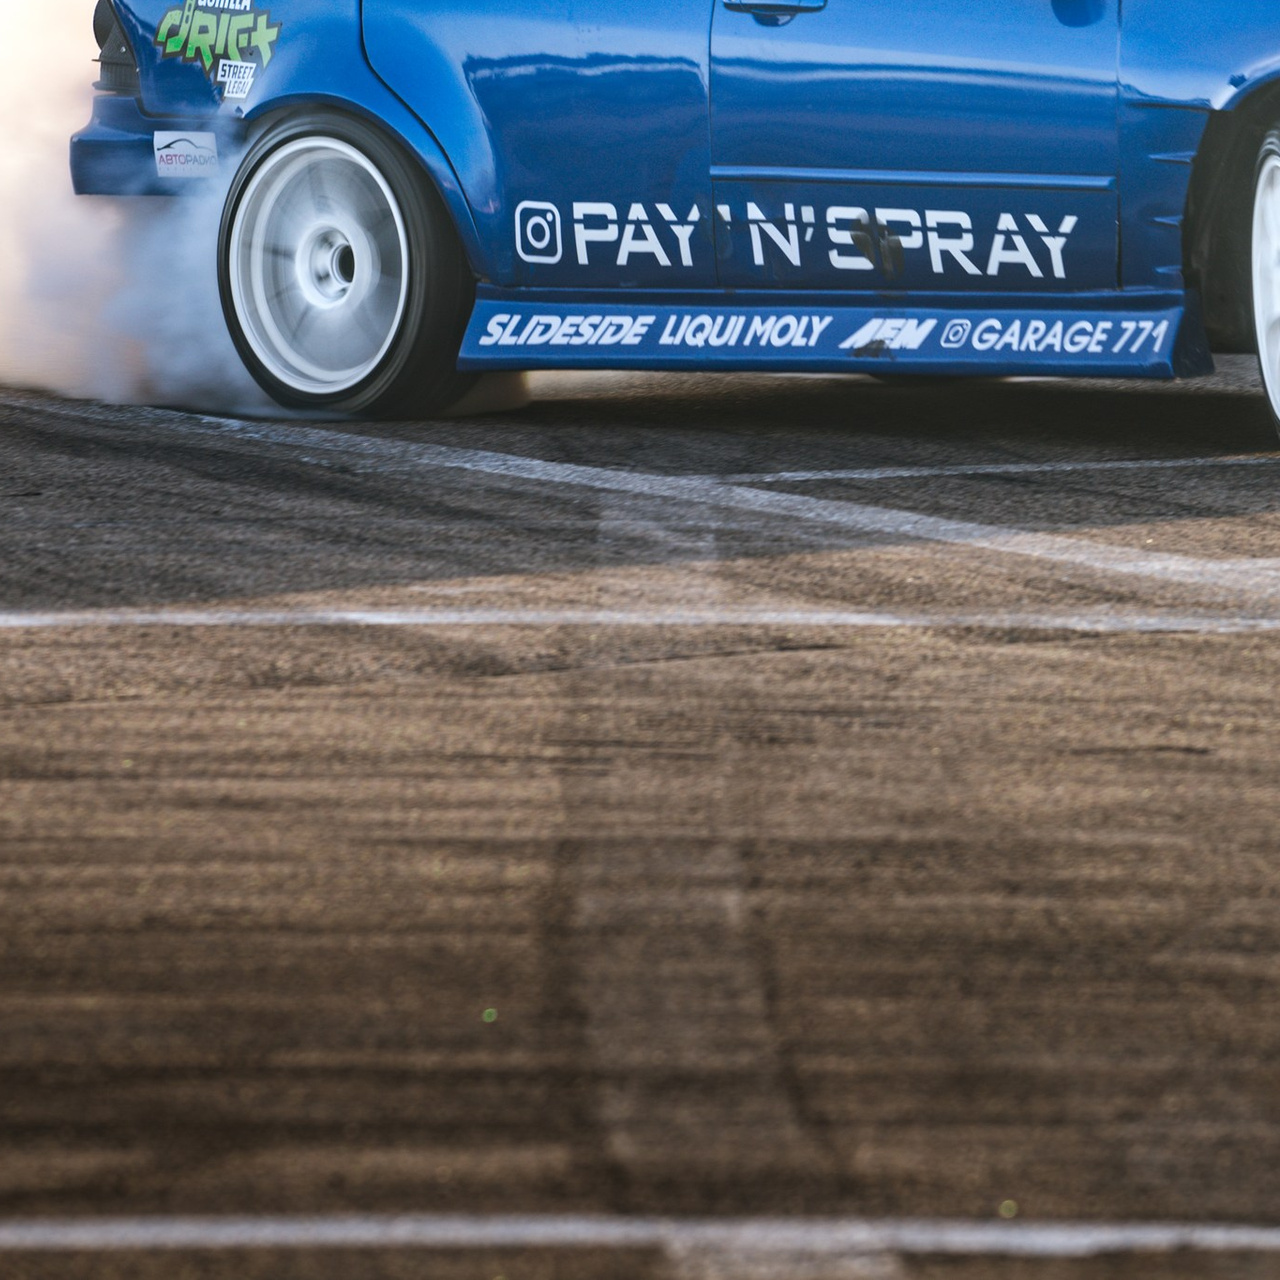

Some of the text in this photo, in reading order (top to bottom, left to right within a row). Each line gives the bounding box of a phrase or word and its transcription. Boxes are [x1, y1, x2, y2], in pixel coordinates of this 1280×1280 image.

[220, 63, 254, 80] STREET
[226, 80, 250, 95] LEGAL
[478, 314, 656, 346] SLIDESIDE
[658, 314, 746, 348] LIQUI
[743, 315, 834, 347] MOLY
[971, 318, 1114, 353] GARAGE
[1111, 319, 1170, 354] 771
